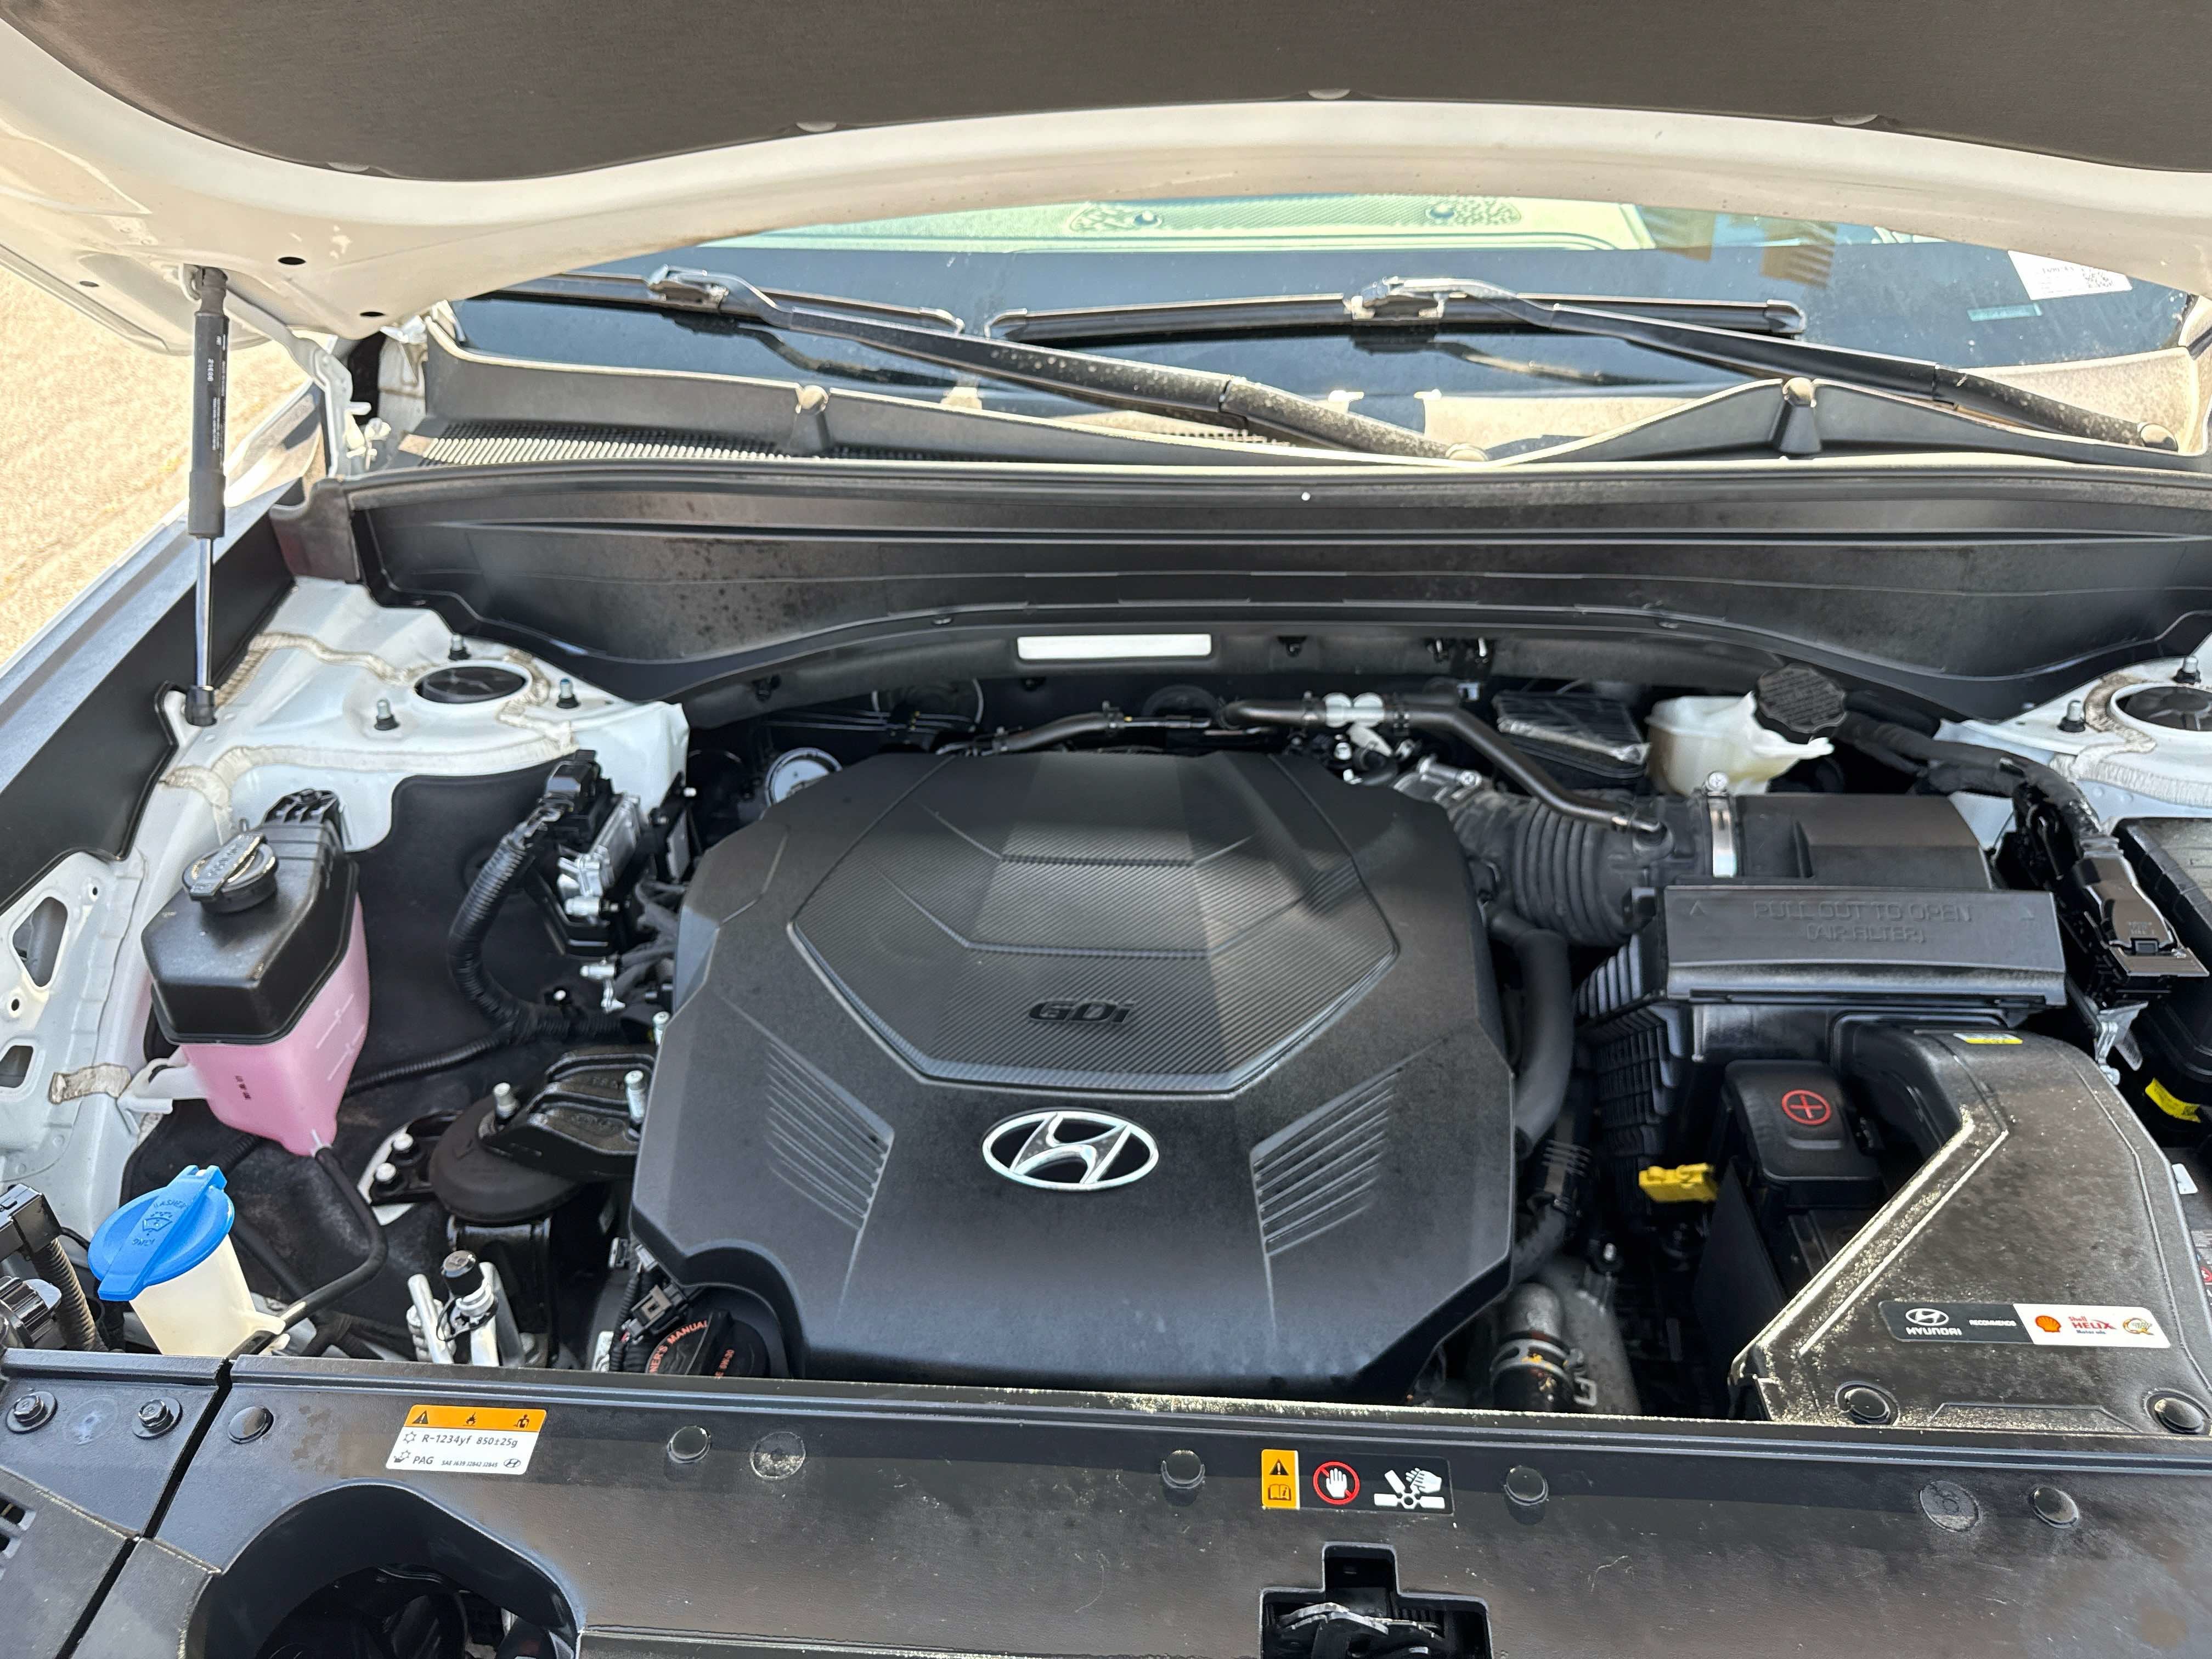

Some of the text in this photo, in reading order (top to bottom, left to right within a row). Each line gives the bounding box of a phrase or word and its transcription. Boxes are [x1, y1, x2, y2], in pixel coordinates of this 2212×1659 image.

[1753, 900, 1973, 922] PULL OUT TO OPEN
[1807, 922, 1927, 944] (AIR FILTER)
[1905, 1327, 1962, 1335] HYUNDAI
[421, 1434, 518, 1448] R-1234yf 850±25g
[413, 1455, 435, 1465] PAG
